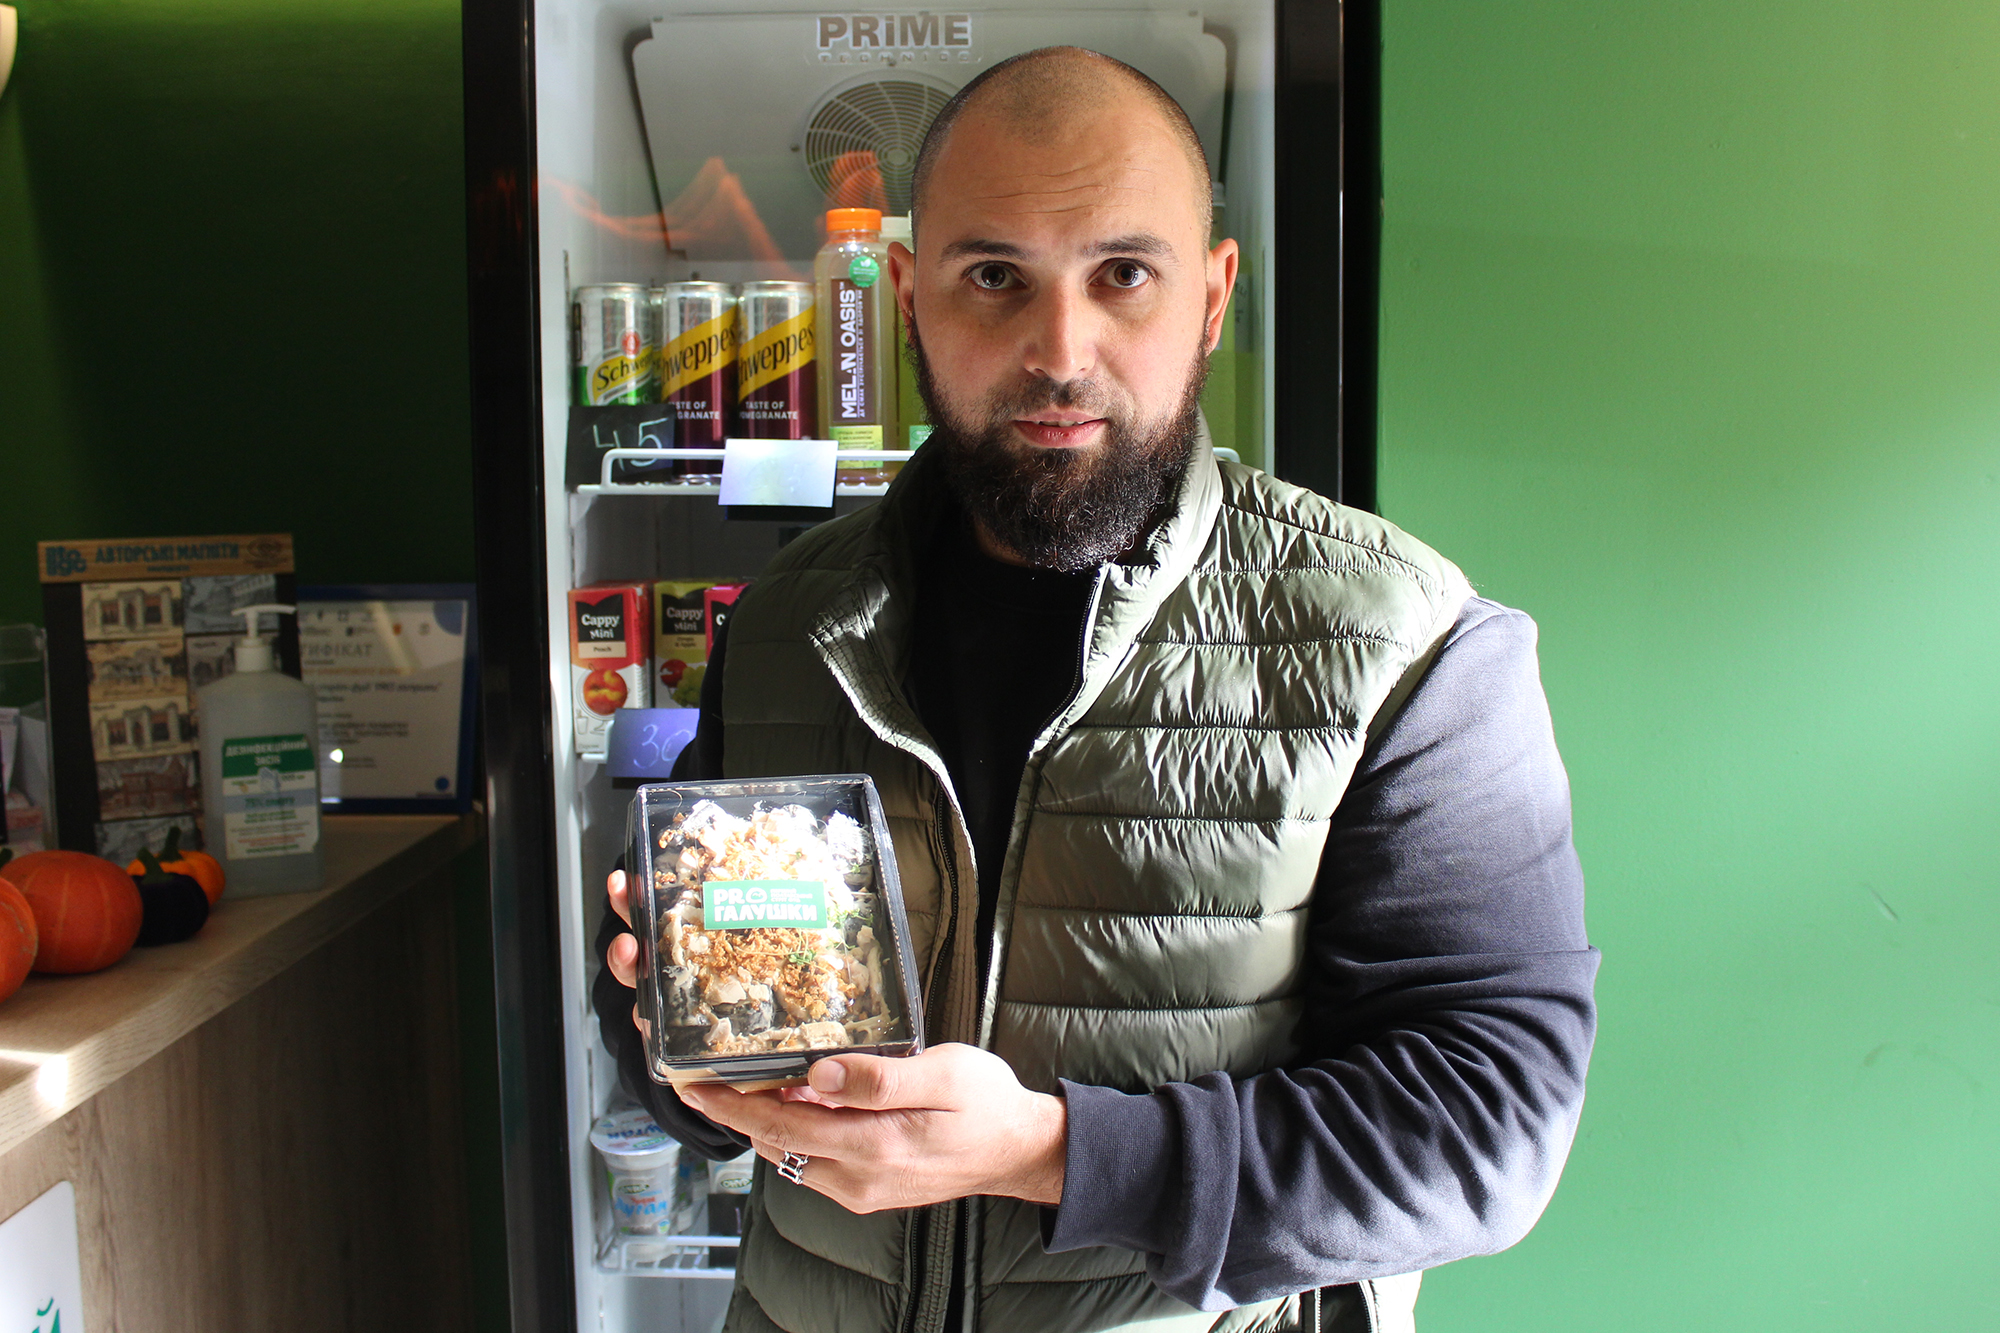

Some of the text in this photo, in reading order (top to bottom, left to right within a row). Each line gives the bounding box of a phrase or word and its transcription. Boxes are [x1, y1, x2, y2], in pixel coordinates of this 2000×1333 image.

[692, 401, 707, 410] OF
[771, 401, 785, 410] OF
[677, 410, 721, 421] GRANATE
[592, 416, 669, 472] 45
[581, 613, 621, 628] Cappy
[666, 606, 704, 621] Cappy
[589, 628, 615, 640] Mini
[713, 887, 767, 905] PRO
[714, 904, 817, 922] ГАЛУШКИ
